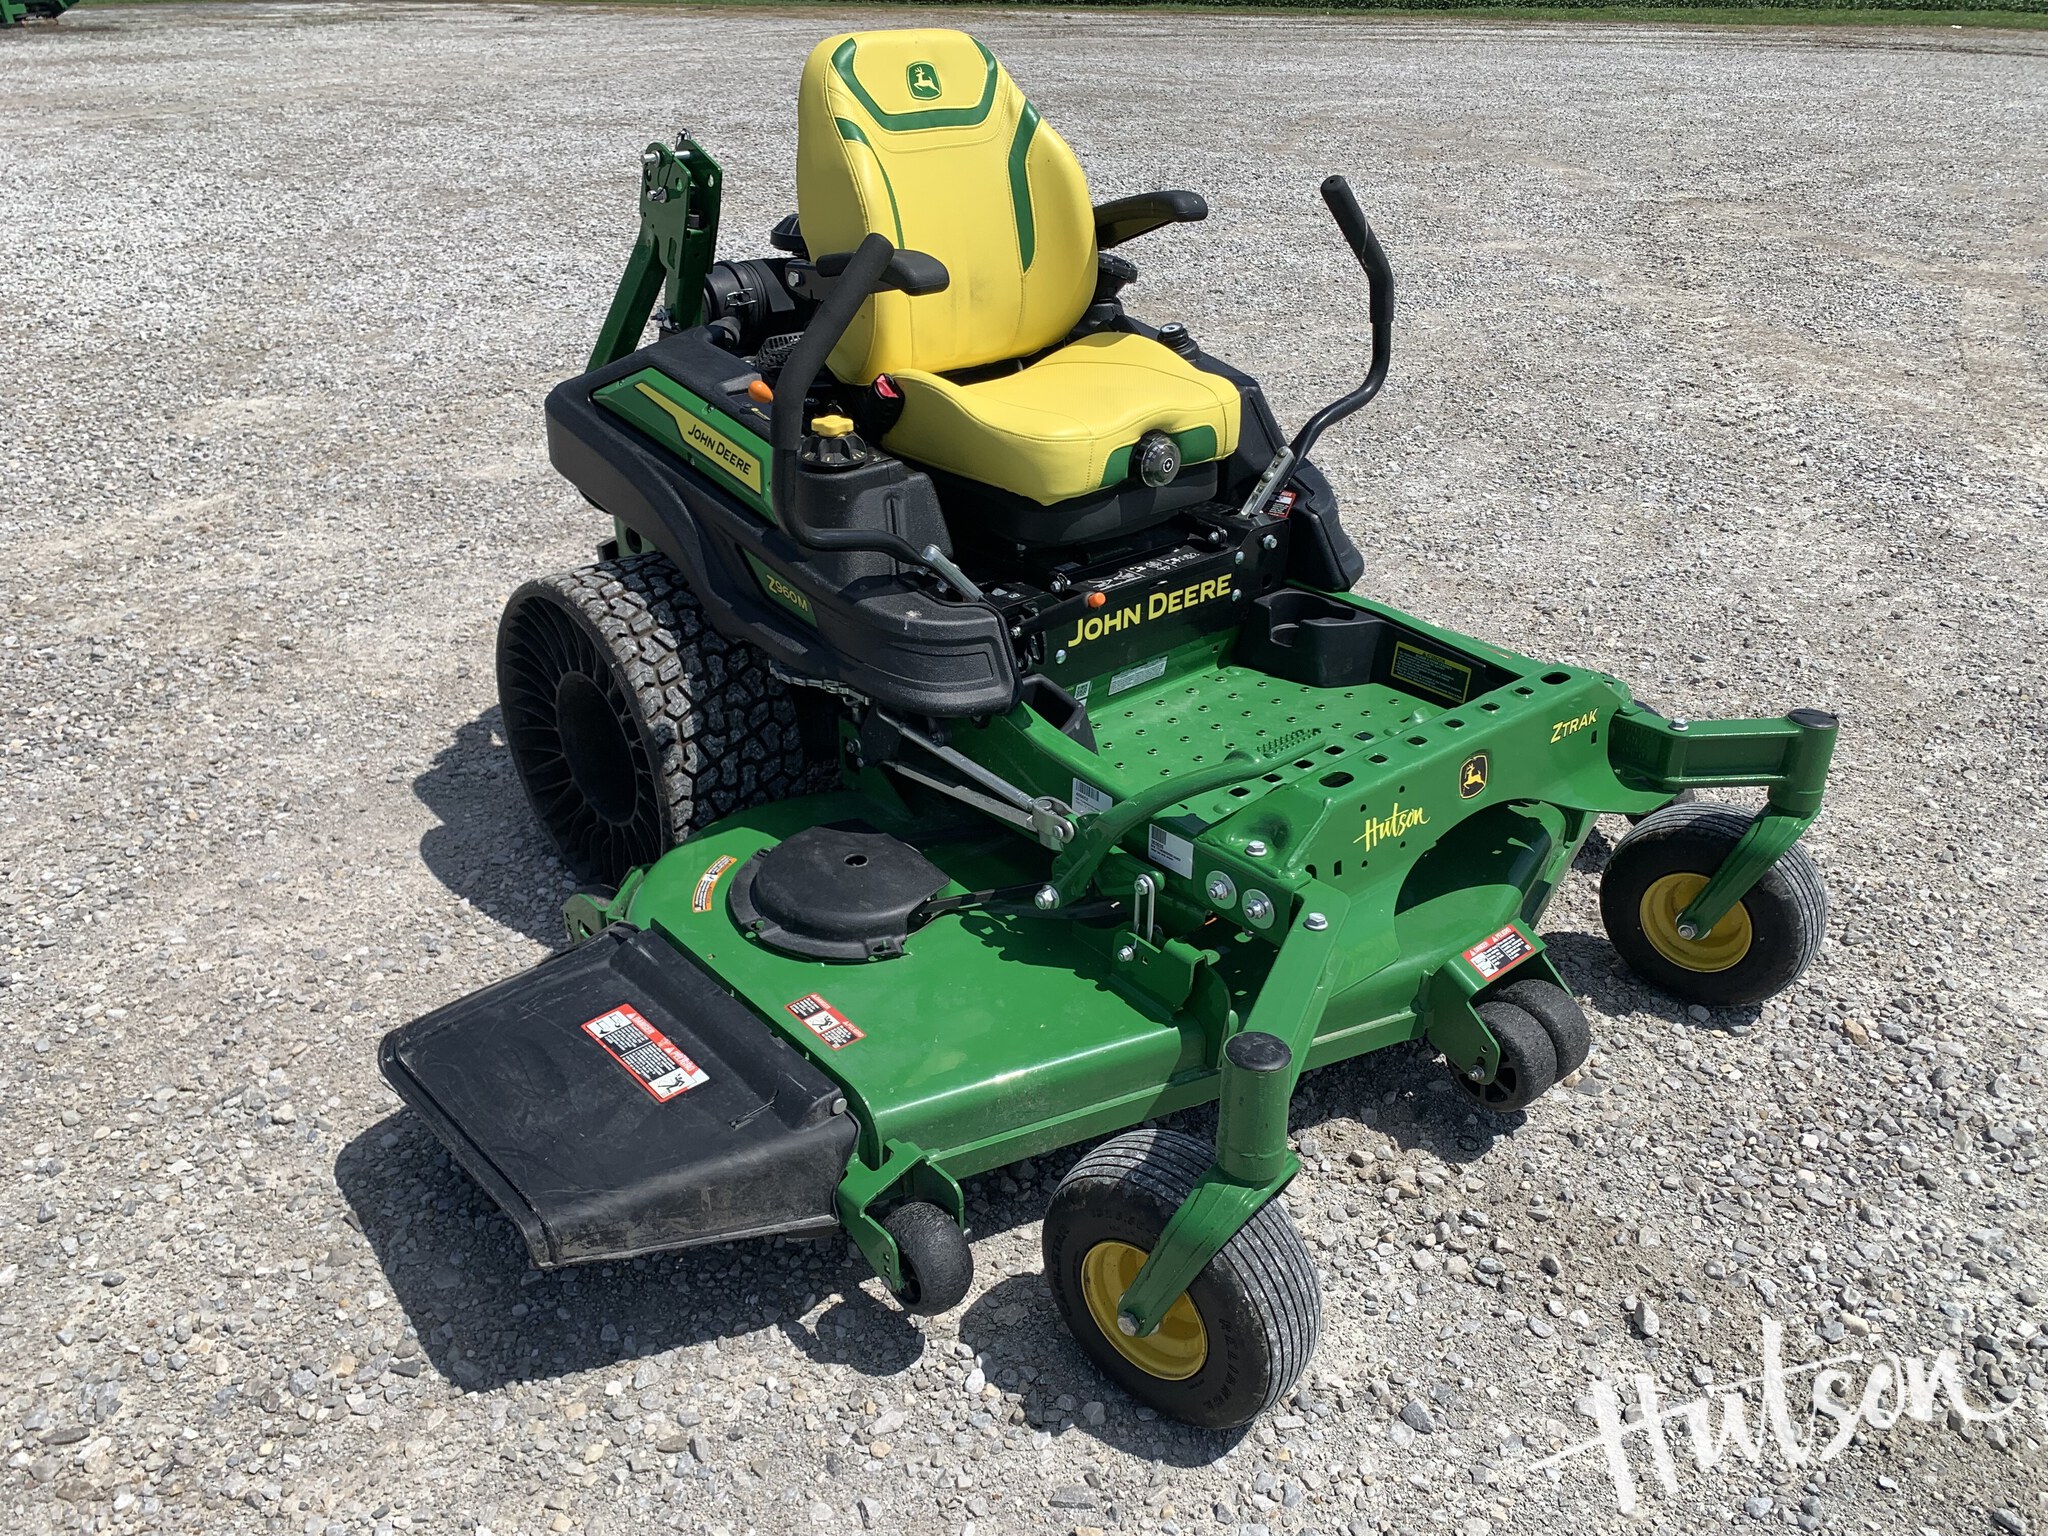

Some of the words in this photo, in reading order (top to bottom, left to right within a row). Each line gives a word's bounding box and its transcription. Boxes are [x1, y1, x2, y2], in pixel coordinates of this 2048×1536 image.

[687, 424, 716, 451] JOHN
[716, 442, 752, 476] DEERE
[766, 574, 809, 612] Z960M
[1068, 603, 1141, 648] JOHN
[1148, 573, 1232, 620] DEERE
[1550, 706, 1600, 745] ZTRAK
[1353, 802, 1432, 852] Hutson
